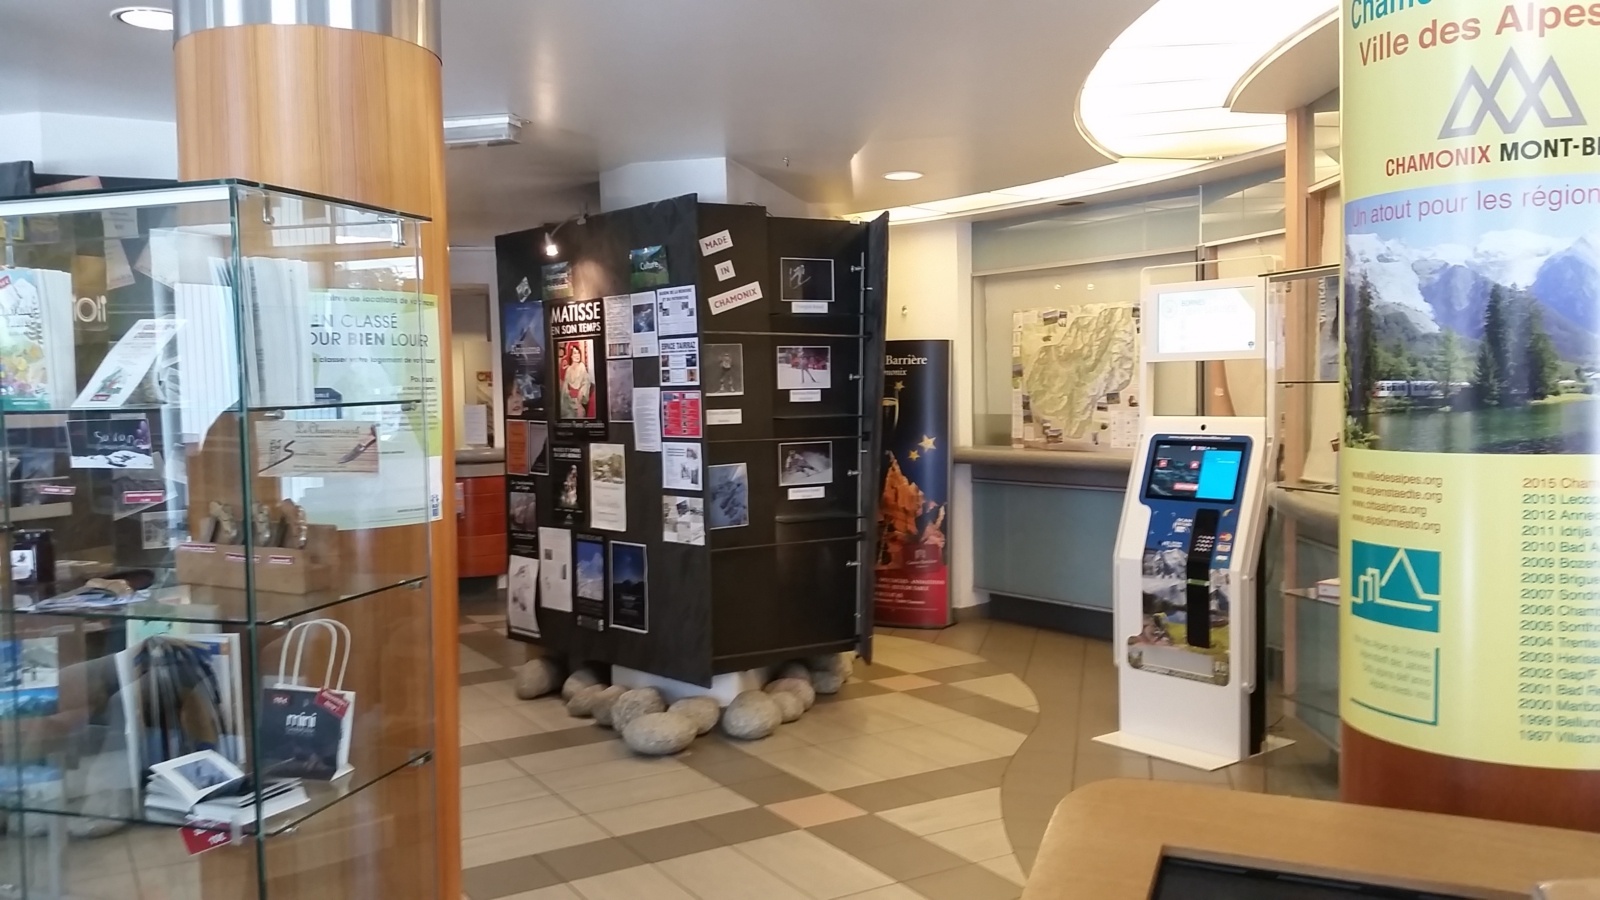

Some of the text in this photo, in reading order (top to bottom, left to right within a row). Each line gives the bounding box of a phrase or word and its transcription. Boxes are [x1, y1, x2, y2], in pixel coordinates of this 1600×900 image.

[1351, 0, 1432, 29] Cha
[1359, 2, 1600, 66] Ville des Alpes
[1386, 145, 1491, 176] CHAMONIX
[1352, 184, 1600, 228] Un atout pour les région
[705, 236, 728, 250] MADE
[720, 267, 731, 276] IN
[713, 287, 758, 310] CHAMONIX
[551, 302, 601, 323] MATISSE
[311, 312, 398, 329] EN CLASSÉ
[551, 321, 601, 336] EN SON TEMPS
[311, 332, 429, 347] OUR BIEN LOUER
[885, 354, 928, 366] Barrière
[1522, 477, 1557, 489] 2015
[1522, 493, 1556, 505] 2013
[1522, 509, 1556, 521] 2012
[1522, 525, 1554, 536] 2011
[1522, 541, 1556, 552] 2010
[1561, 541, 1586, 553] Bad
[1521, 556, 1555, 568] 2009
[1521, 572, 1555, 584] 2008
[1521, 588, 1554, 600] 2007
[1520, 604, 1554, 616] 2006
[1520, 620, 1554, 632] 2005
[1520, 635, 1553, 647] 2004
[1520, 651, 1553, 663] 2003
[1519, 667, 1553, 679] 2002
[1519, 683, 1551, 694] 2001
[1557, 684, 1585, 696] Bad
[1518, 698, 1553, 710] 2000
[285, 711, 317, 728] mini
[1519, 714, 1553, 726] 1999
[1519, 729, 1553, 742] 1997
